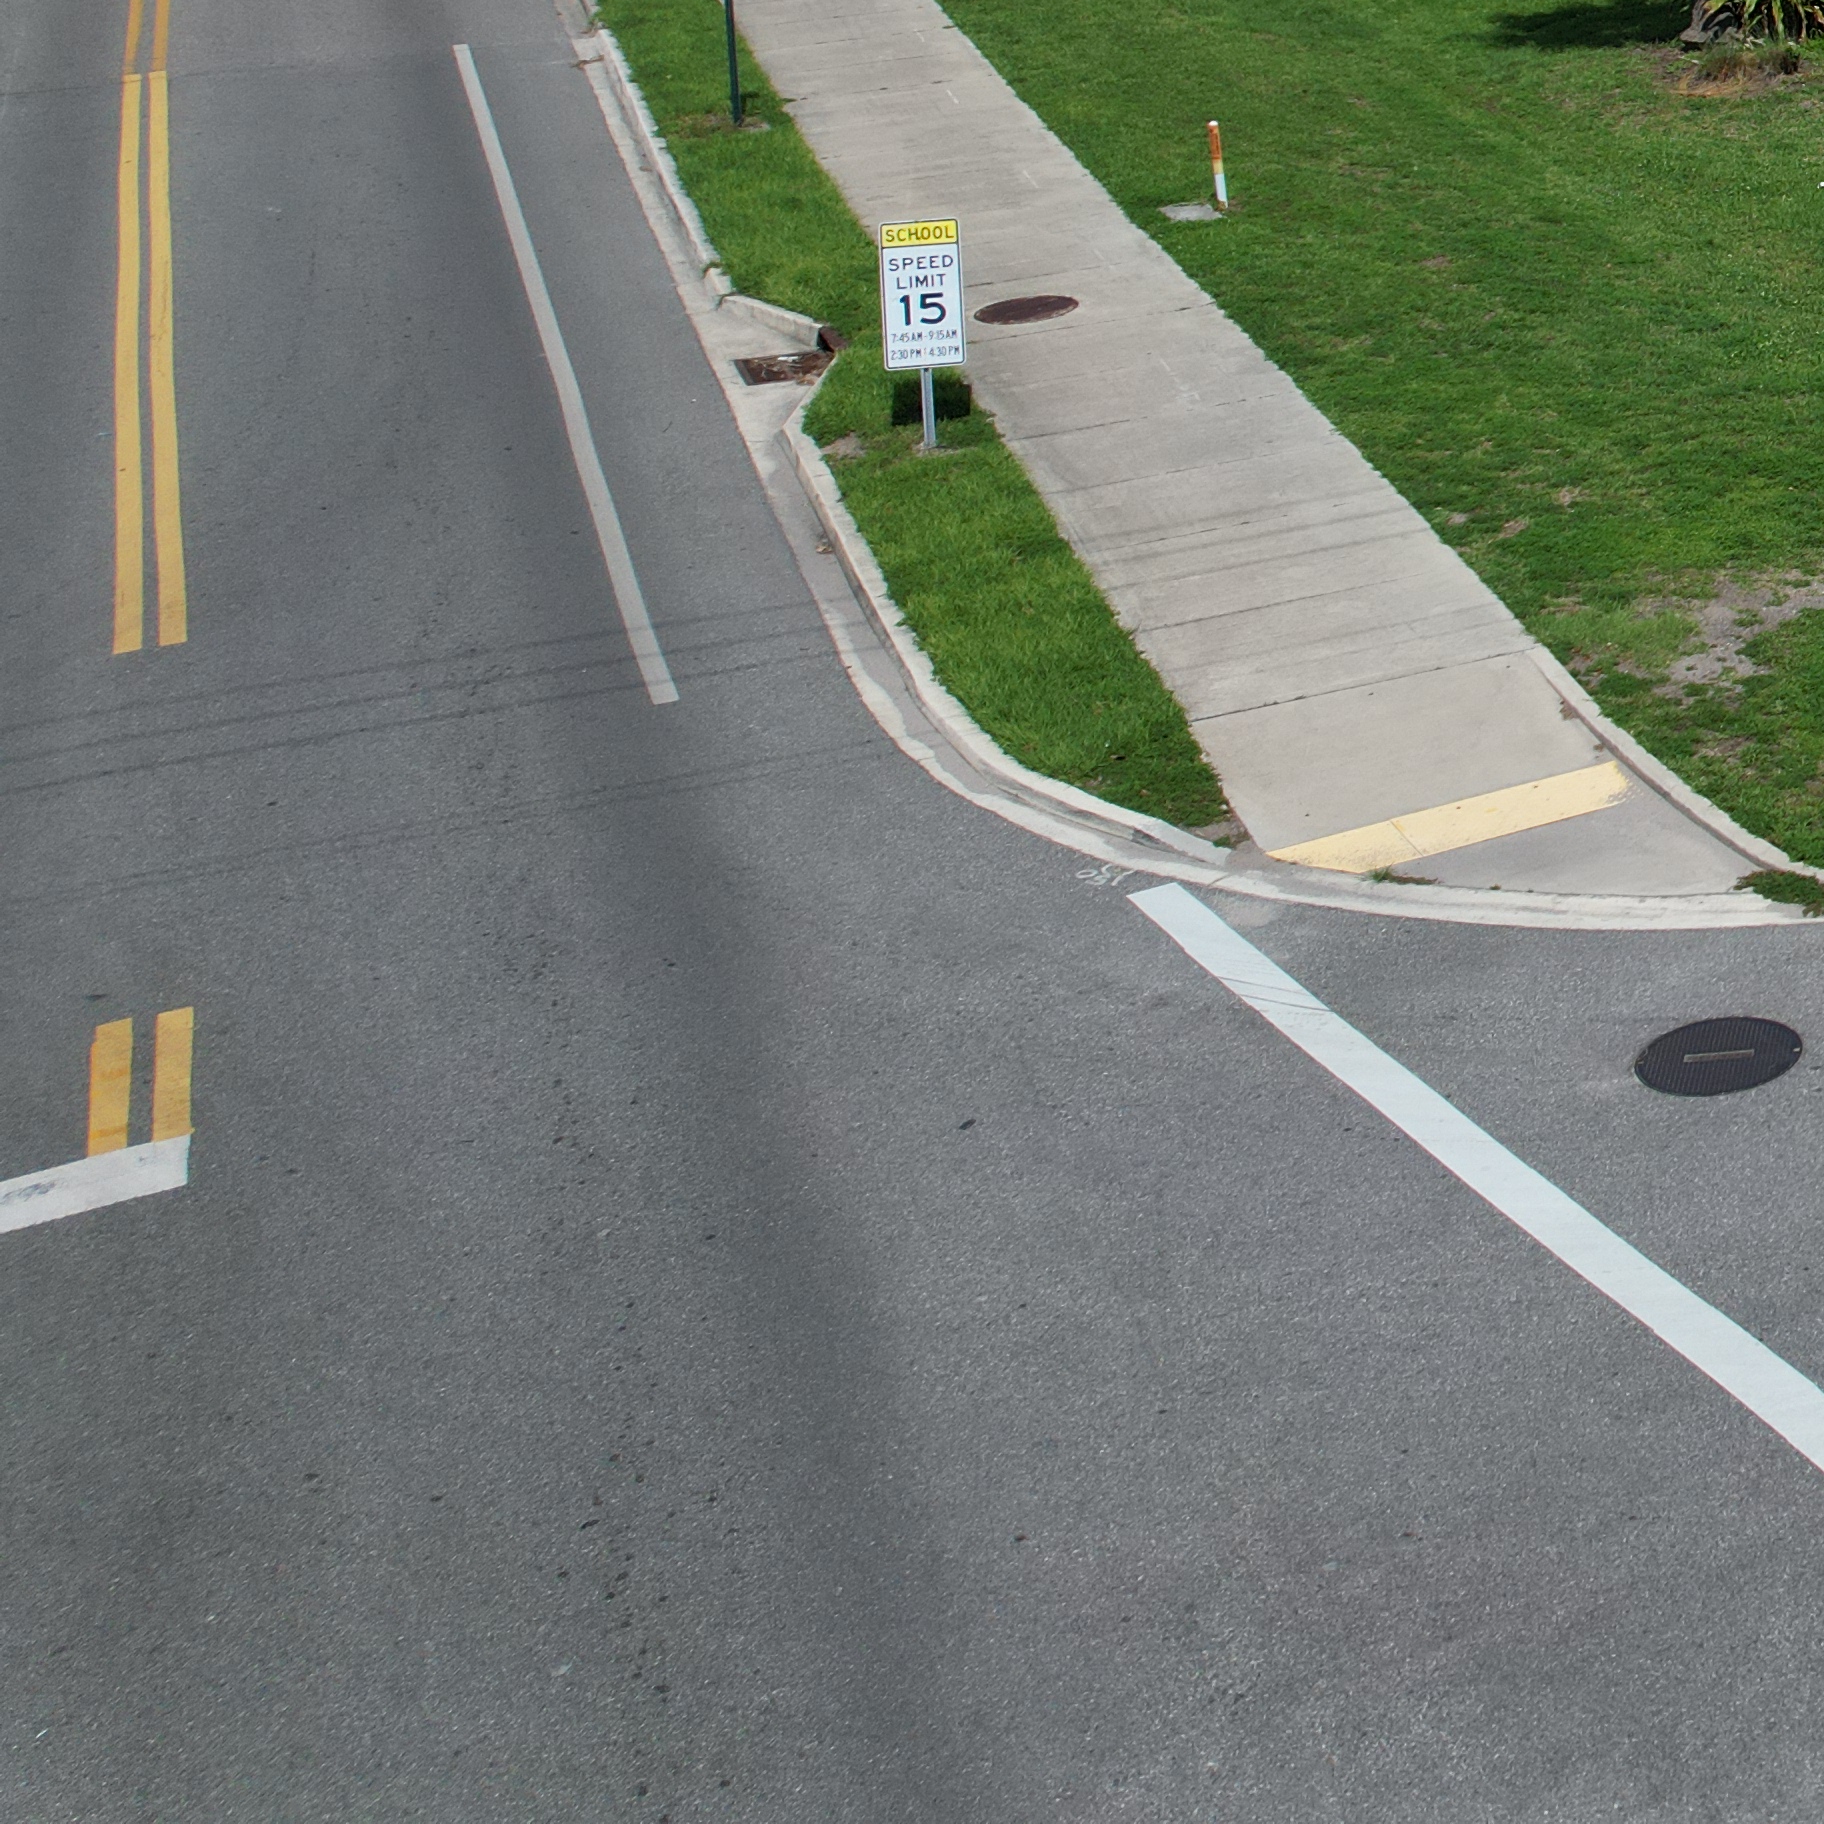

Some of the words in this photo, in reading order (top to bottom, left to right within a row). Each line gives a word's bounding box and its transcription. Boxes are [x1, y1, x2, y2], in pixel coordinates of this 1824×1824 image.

[885, 225, 954, 243] SCHOOL
[889, 255, 953, 271] SPEED
[896, 273, 946, 290] LIMIT
[899, 292, 947, 326] 15
